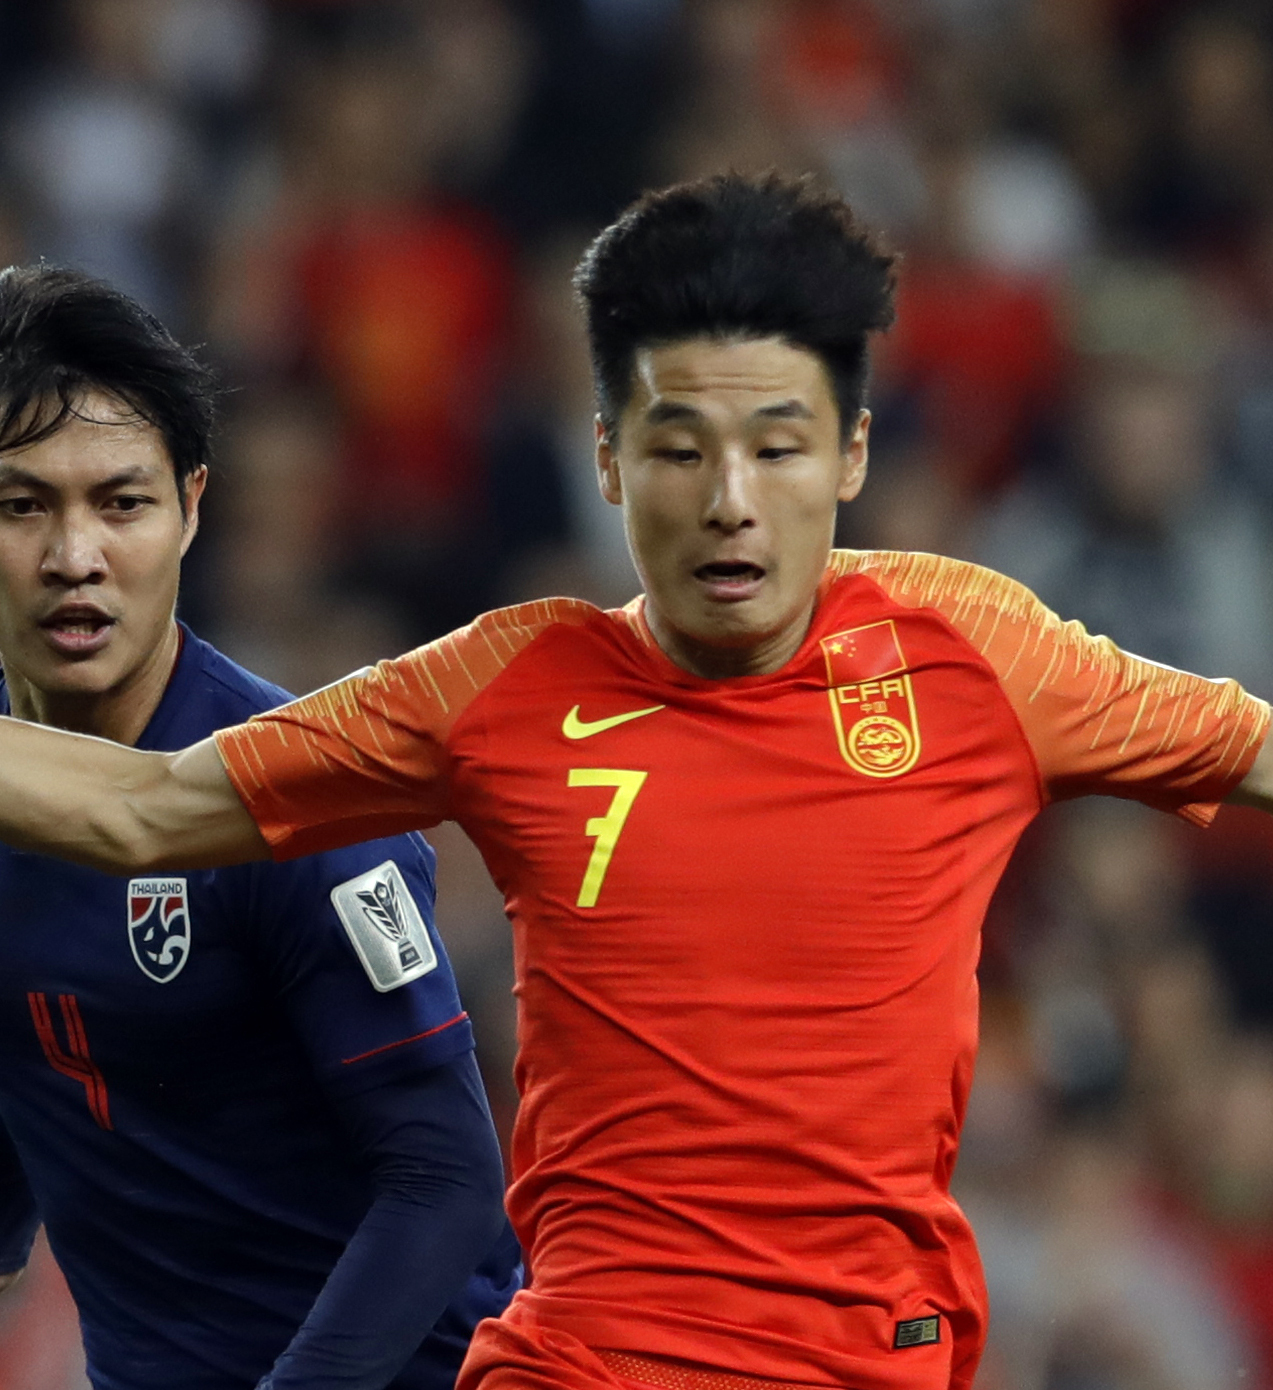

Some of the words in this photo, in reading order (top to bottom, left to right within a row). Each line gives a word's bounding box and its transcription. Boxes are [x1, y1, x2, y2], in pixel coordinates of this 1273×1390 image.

[837, 679, 904, 703] CFA
[567, 768, 648, 907] 7
[131, 883, 182, 895] THAILAND
[27, 992, 114, 1131] 4
